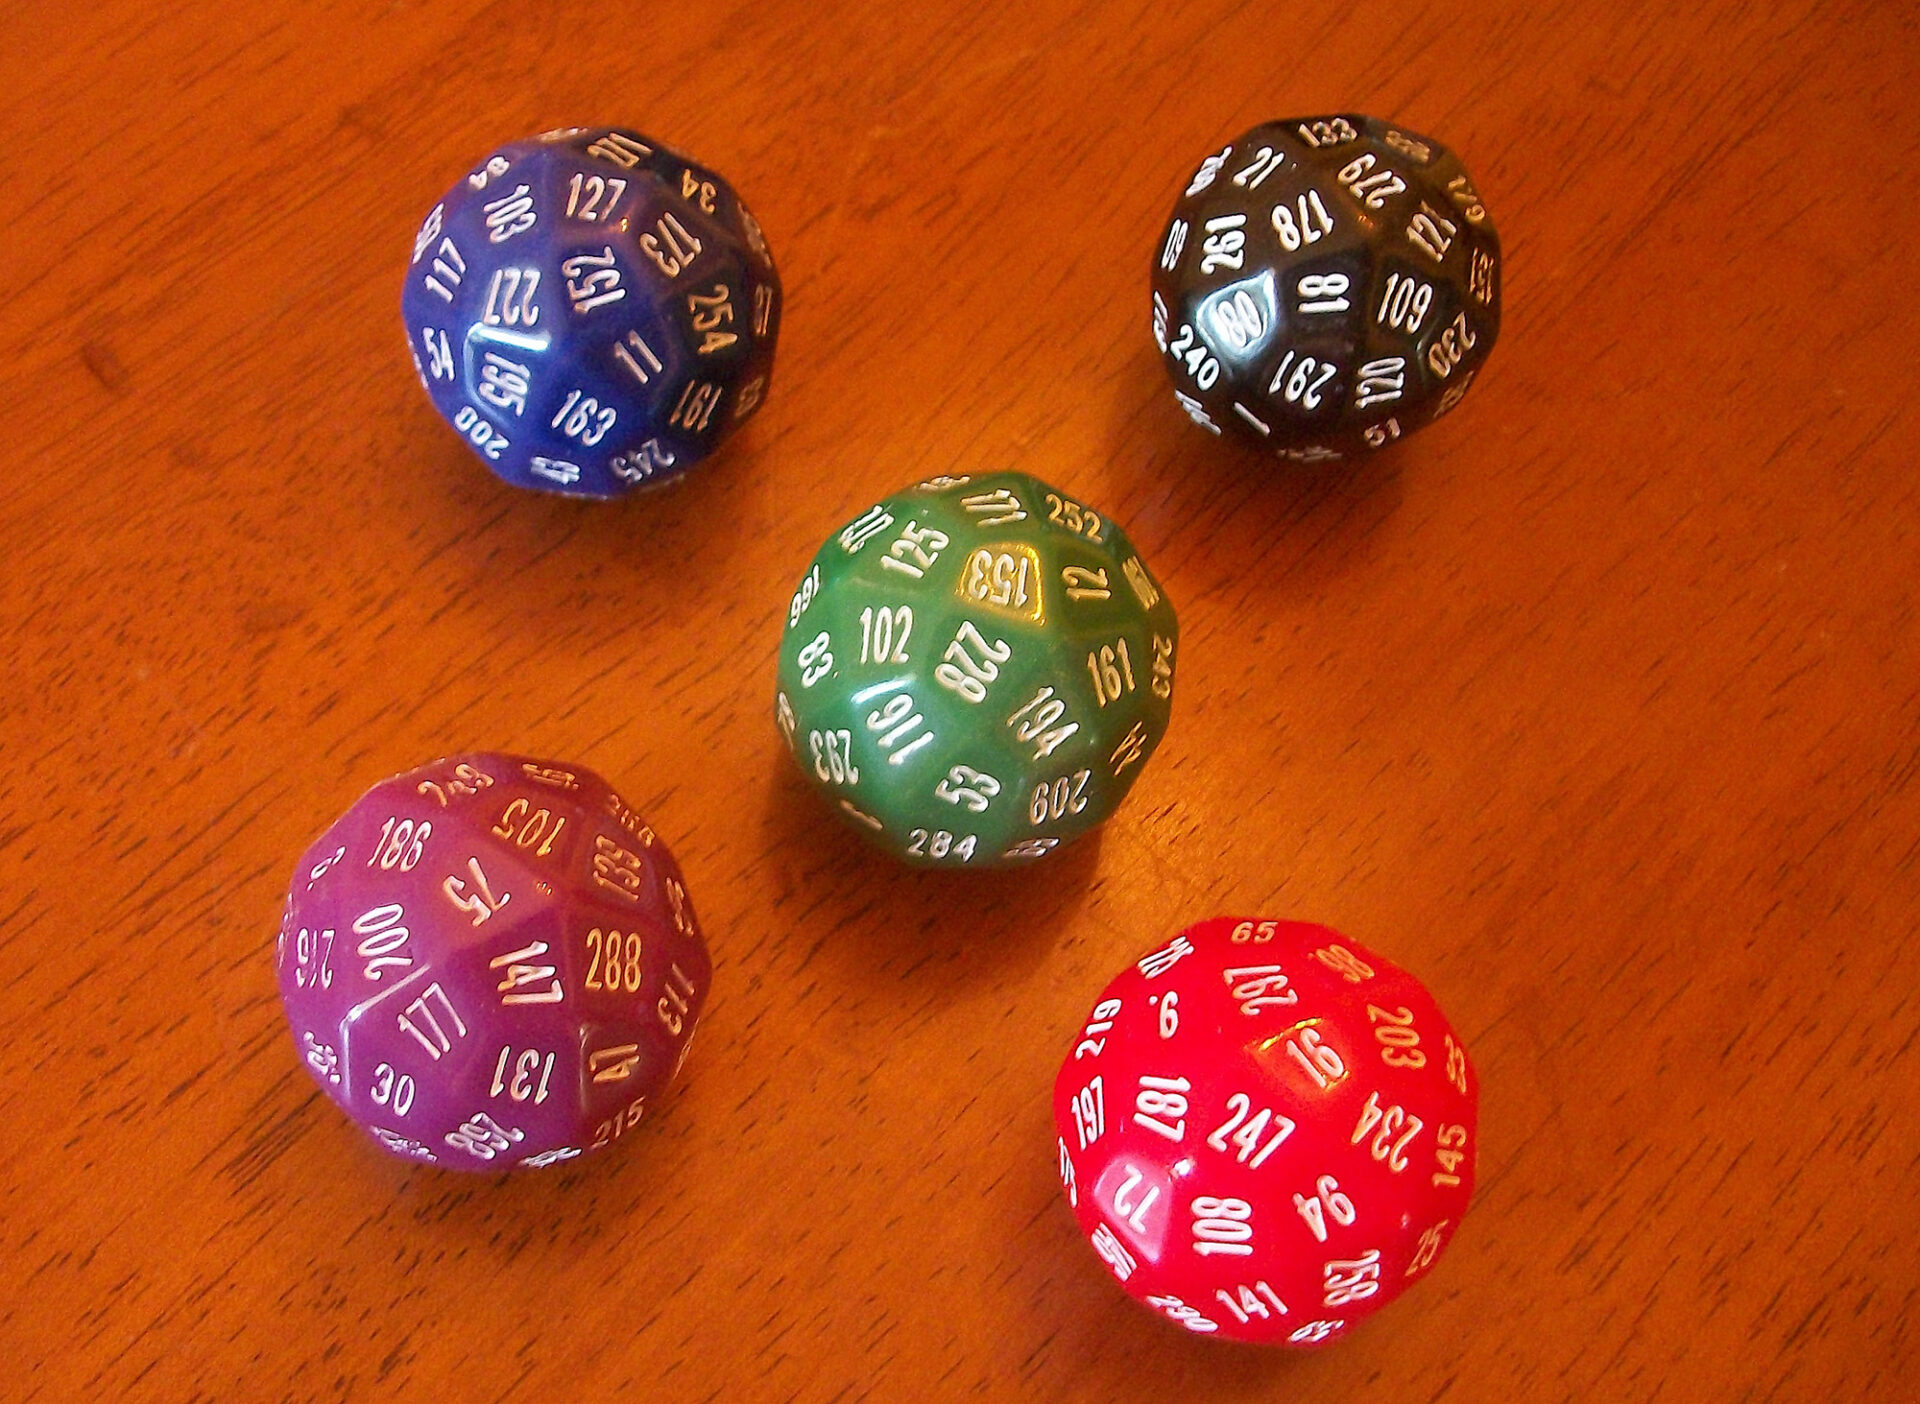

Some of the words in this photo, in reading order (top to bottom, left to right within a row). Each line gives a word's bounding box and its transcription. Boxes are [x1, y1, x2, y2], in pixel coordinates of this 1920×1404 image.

[566, 173, 626, 221] 127
[681, 168, 717, 214] 34
[1232, 146, 1286, 191] 21
[1337, 153, 1407, 209] 279
[483, 184, 537, 243] 103
[1200, 213, 1247, 275] 261
[1270, 188, 1335, 252] 178
[1405, 200, 1458, 263] 121
[425, 237, 466, 303] 117
[639, 211, 701, 278] 173
[484, 269, 541, 326] 227
[562, 246, 626, 313] 152
[1376, 272, 1434, 335] 109
[687, 284, 738, 354] 254
[1216, 288, 1264, 348] 80
[1428, 311, 1477, 379] 230
[423, 326, 454, 381] 54
[479, 352, 531, 416] 195
[613, 329, 662, 384] 11
[1169, 323, 1221, 392] 240
[1268, 350, 1337, 411] 291
[1354, 356, 1406, 410] 120
[454, 406, 509, 460] 200
[552, 389, 617, 447] 163
[1233, 401, 1271, 436] 1
[1045, 494, 1104, 543] 252
[880, 520, 950, 579] 125
[966, 548, 1030, 608] 153
[790, 564, 820, 629] 166
[1061, 565, 1112, 602] 12
[797, 631, 835, 690] 83
[858, 604, 914, 665] 102
[934, 620, 1013, 705] 228
[1086, 636, 1137, 709] 161
[1151, 633, 1174, 700] 243
[865, 693, 936, 766] 116
[1006, 685, 1081, 762] 194
[809, 728, 860, 786] 293
[934, 764, 1002, 813] 53
[1029, 768, 1093, 826] 209
[366, 816, 434, 873] 186
[490, 798, 567, 858] 105
[908, 827, 978, 864] 284
[443, 856, 512, 927] 75
[584, 927, 643, 995] 288
[1231, 920, 1280, 946] 65
[488, 940, 565, 1007] 147
[656, 961, 697, 1037] 113
[1222, 964, 1300, 1017] 297
[397, 981, 468, 1062] 177
[1075, 998, 1122, 1061] 219
[1366, 1003, 1428, 1070] 203
[369, 1062, 417, 1119] 30
[489, 1044, 557, 1106] 131
[588, 1044, 640, 1085] 47
[591, 1096, 647, 1151] 215
[1070, 1075, 1104, 1151] 197
[1132, 1075, 1192, 1142] 187
[1206, 1093, 1296, 1170] 247
[1350, 1090, 1424, 1173] 234
[1432, 1122, 1467, 1188] 145
[1112, 1163, 1162, 1235] 72
[1190, 1195, 1254, 1257] 108
[1292, 1174, 1357, 1243] 94
[1216, 1280, 1289, 1324] 141
[1322, 1248, 1382, 1308] 258
